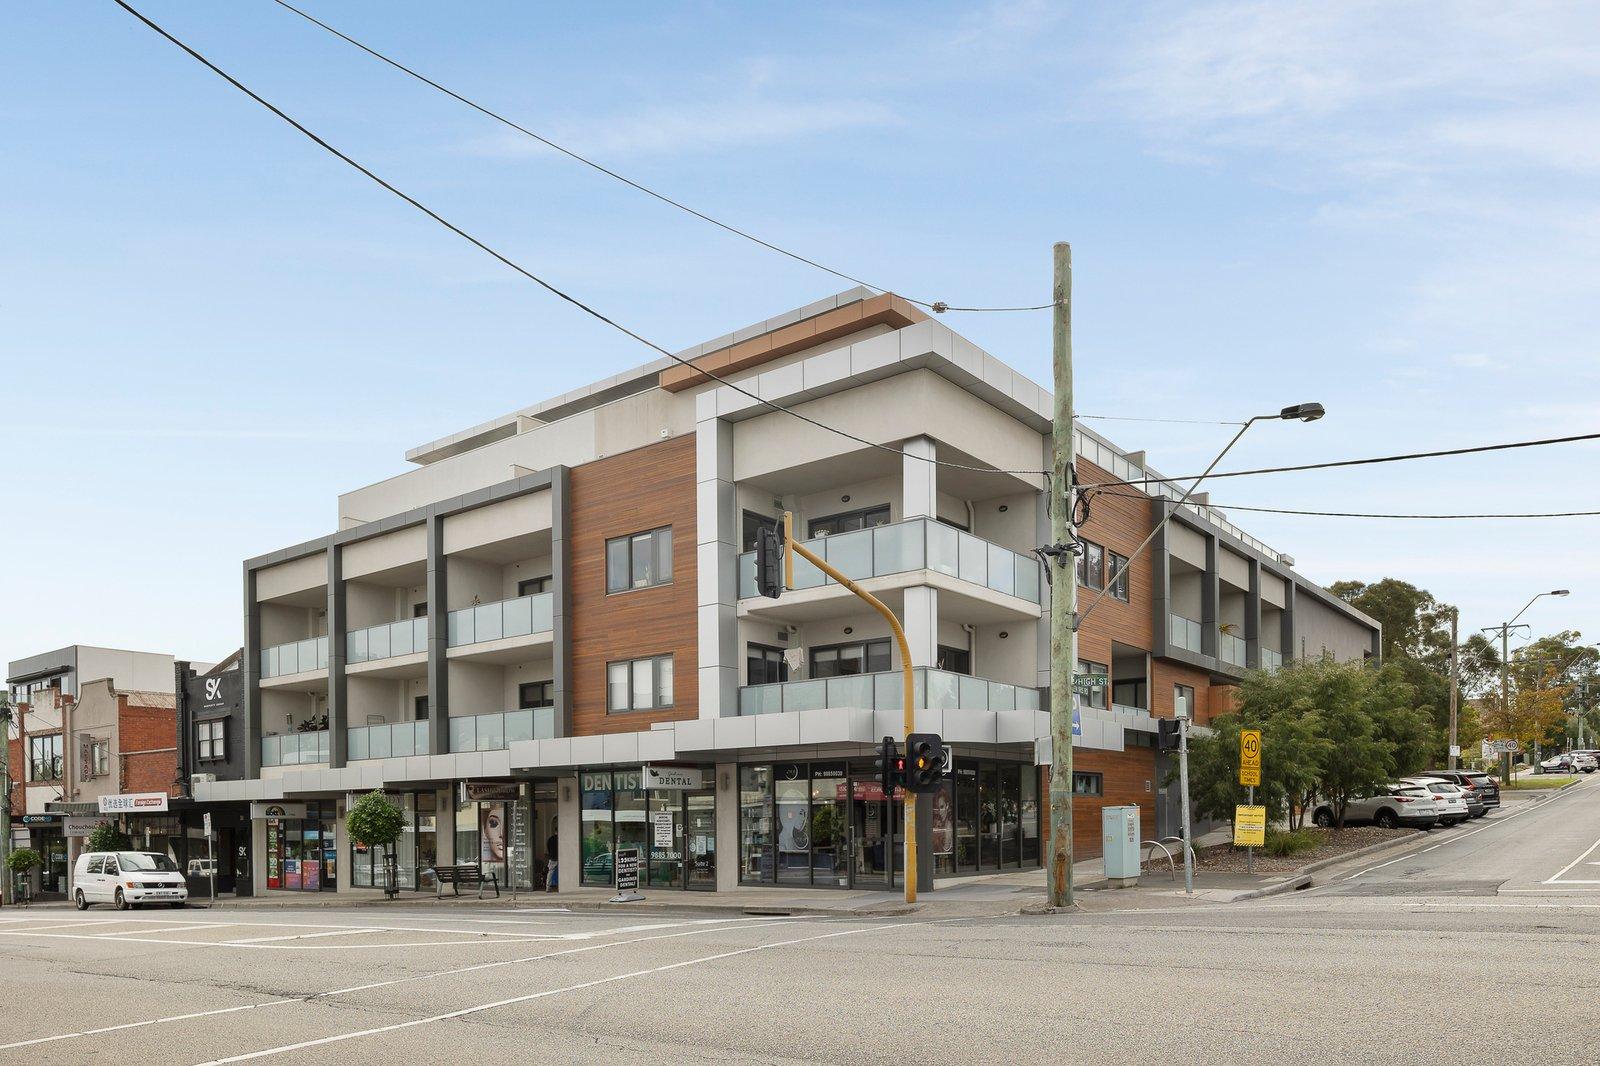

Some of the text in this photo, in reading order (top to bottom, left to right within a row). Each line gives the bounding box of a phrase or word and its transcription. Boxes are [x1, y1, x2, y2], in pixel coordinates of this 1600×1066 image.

[1078, 677, 1107, 687] HIGH ST
[1244, 739, 1257, 752] 40
[1243, 759, 1259, 767] AHEAD
[1241, 770, 1258, 778] SCHOOL
[584, 773, 643, 791] DENTIST
[659, 777, 692, 786] DENTAL
